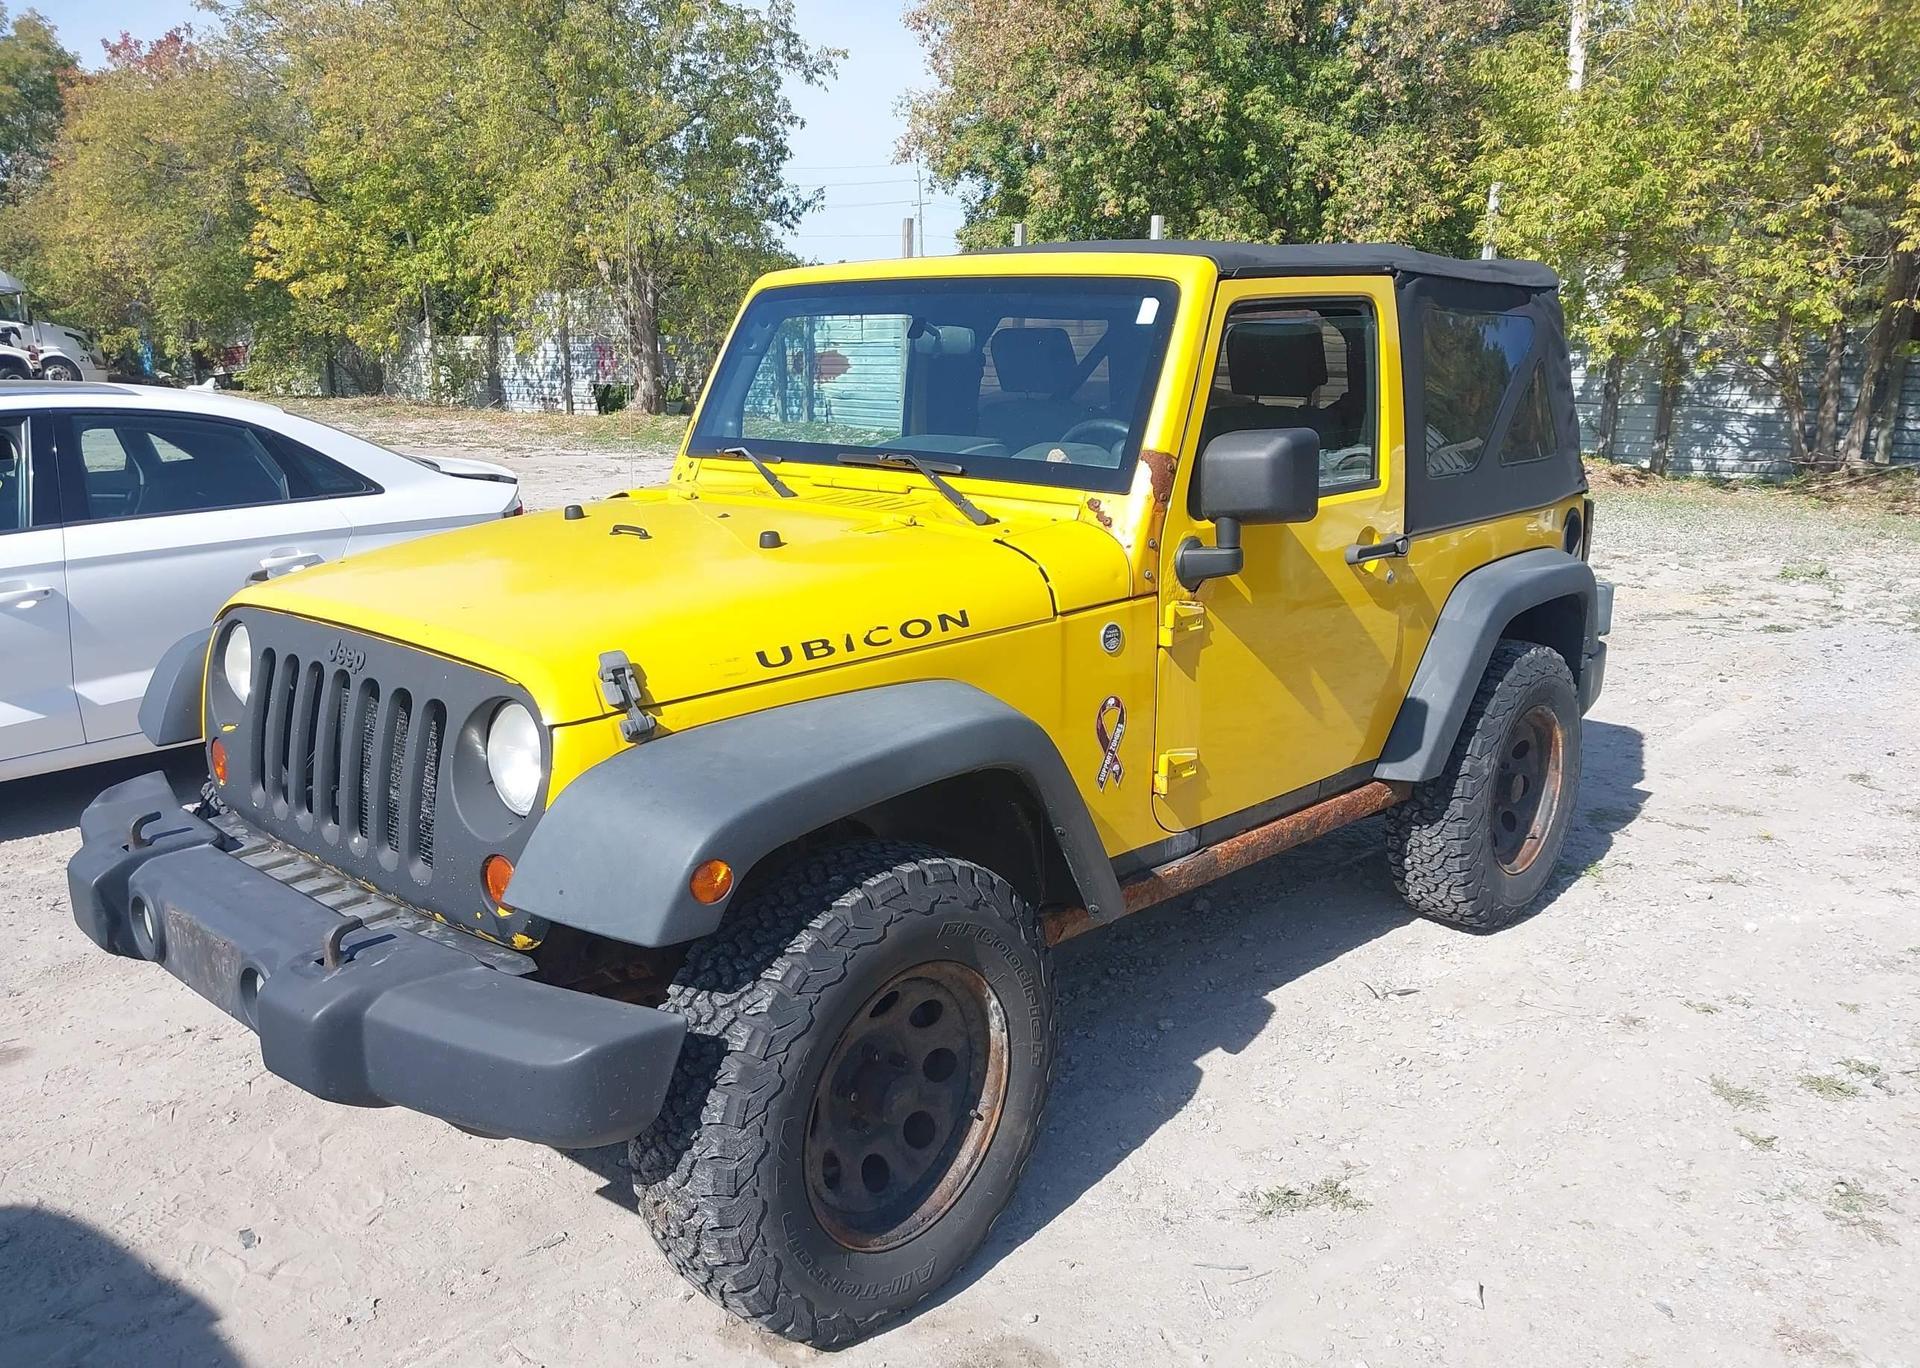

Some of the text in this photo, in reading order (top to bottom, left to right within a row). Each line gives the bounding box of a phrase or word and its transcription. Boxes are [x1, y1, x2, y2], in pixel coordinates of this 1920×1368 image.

[328, 638, 366, 675] Jeep
[755, 609, 970, 669] UBICON
[1099, 752, 1113, 782] SUPPORT
[936, 920, 1044, 1068] BFGoodrich
